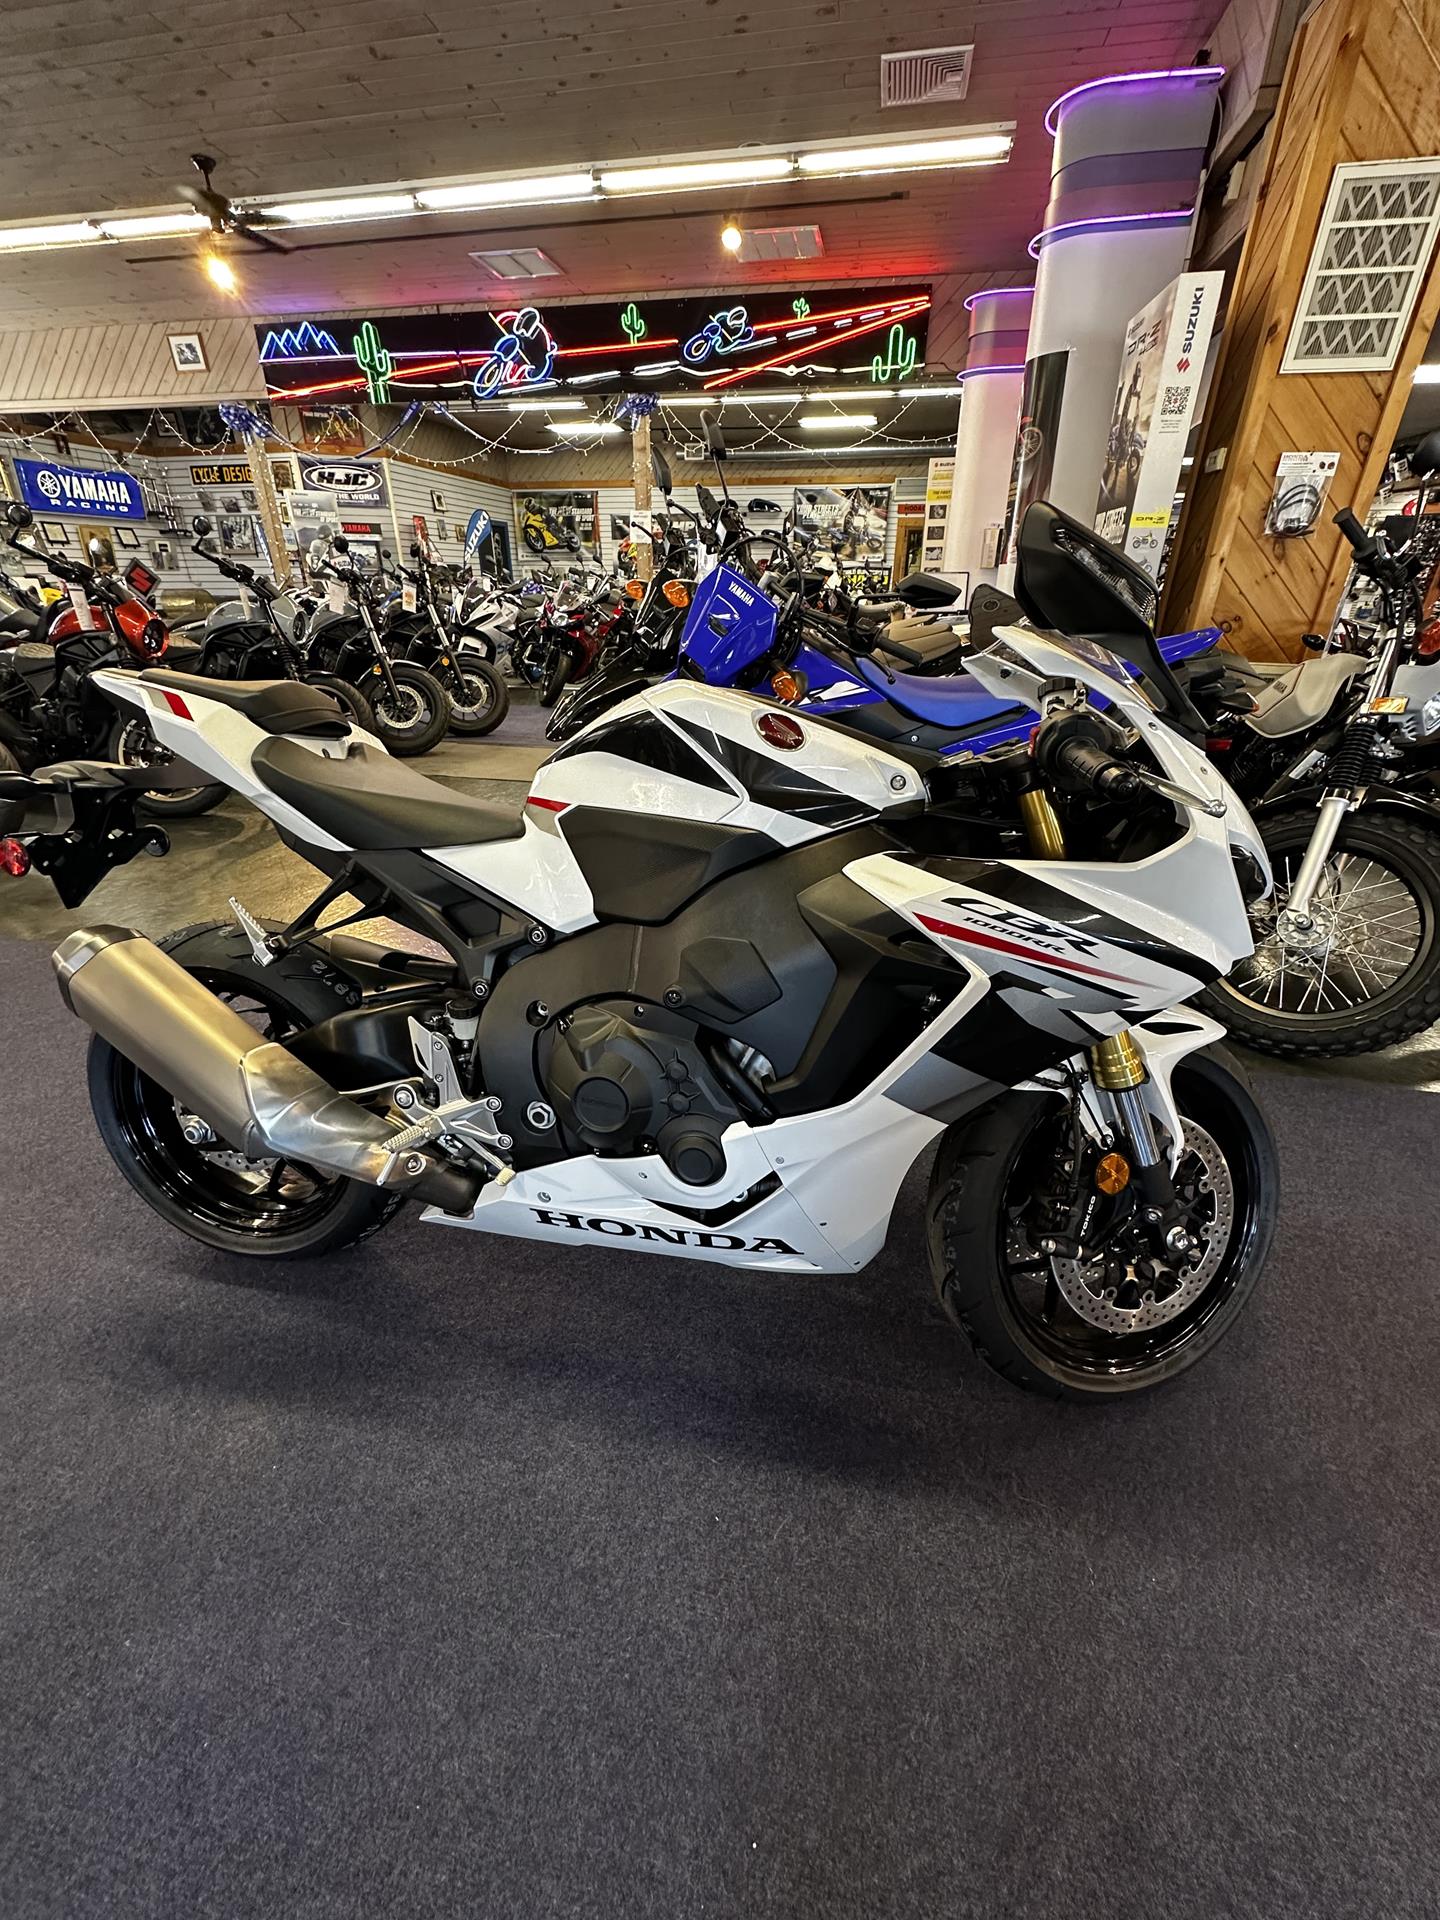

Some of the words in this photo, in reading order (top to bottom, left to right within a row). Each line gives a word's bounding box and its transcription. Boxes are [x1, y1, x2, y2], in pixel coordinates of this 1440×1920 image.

[1182, 286, 1205, 354] SUZUKI
[191, 466, 221, 483] CYCLE
[316, 471, 369, 486] HJC
[58, 474, 132, 505] YAMAHA
[351, 493, 380, 501] WORLD
[49, 499, 129, 513] RACING
[344, 524, 371, 533] YAMAHA
[728, 581, 755, 607] YAMAHA
[940, 897, 1100, 959] CBR
[962, 916, 1067, 954] 1000RR
[1080, 1195, 1096, 1237] TOKICO
[529, 1207, 805, 1255] HONDA
